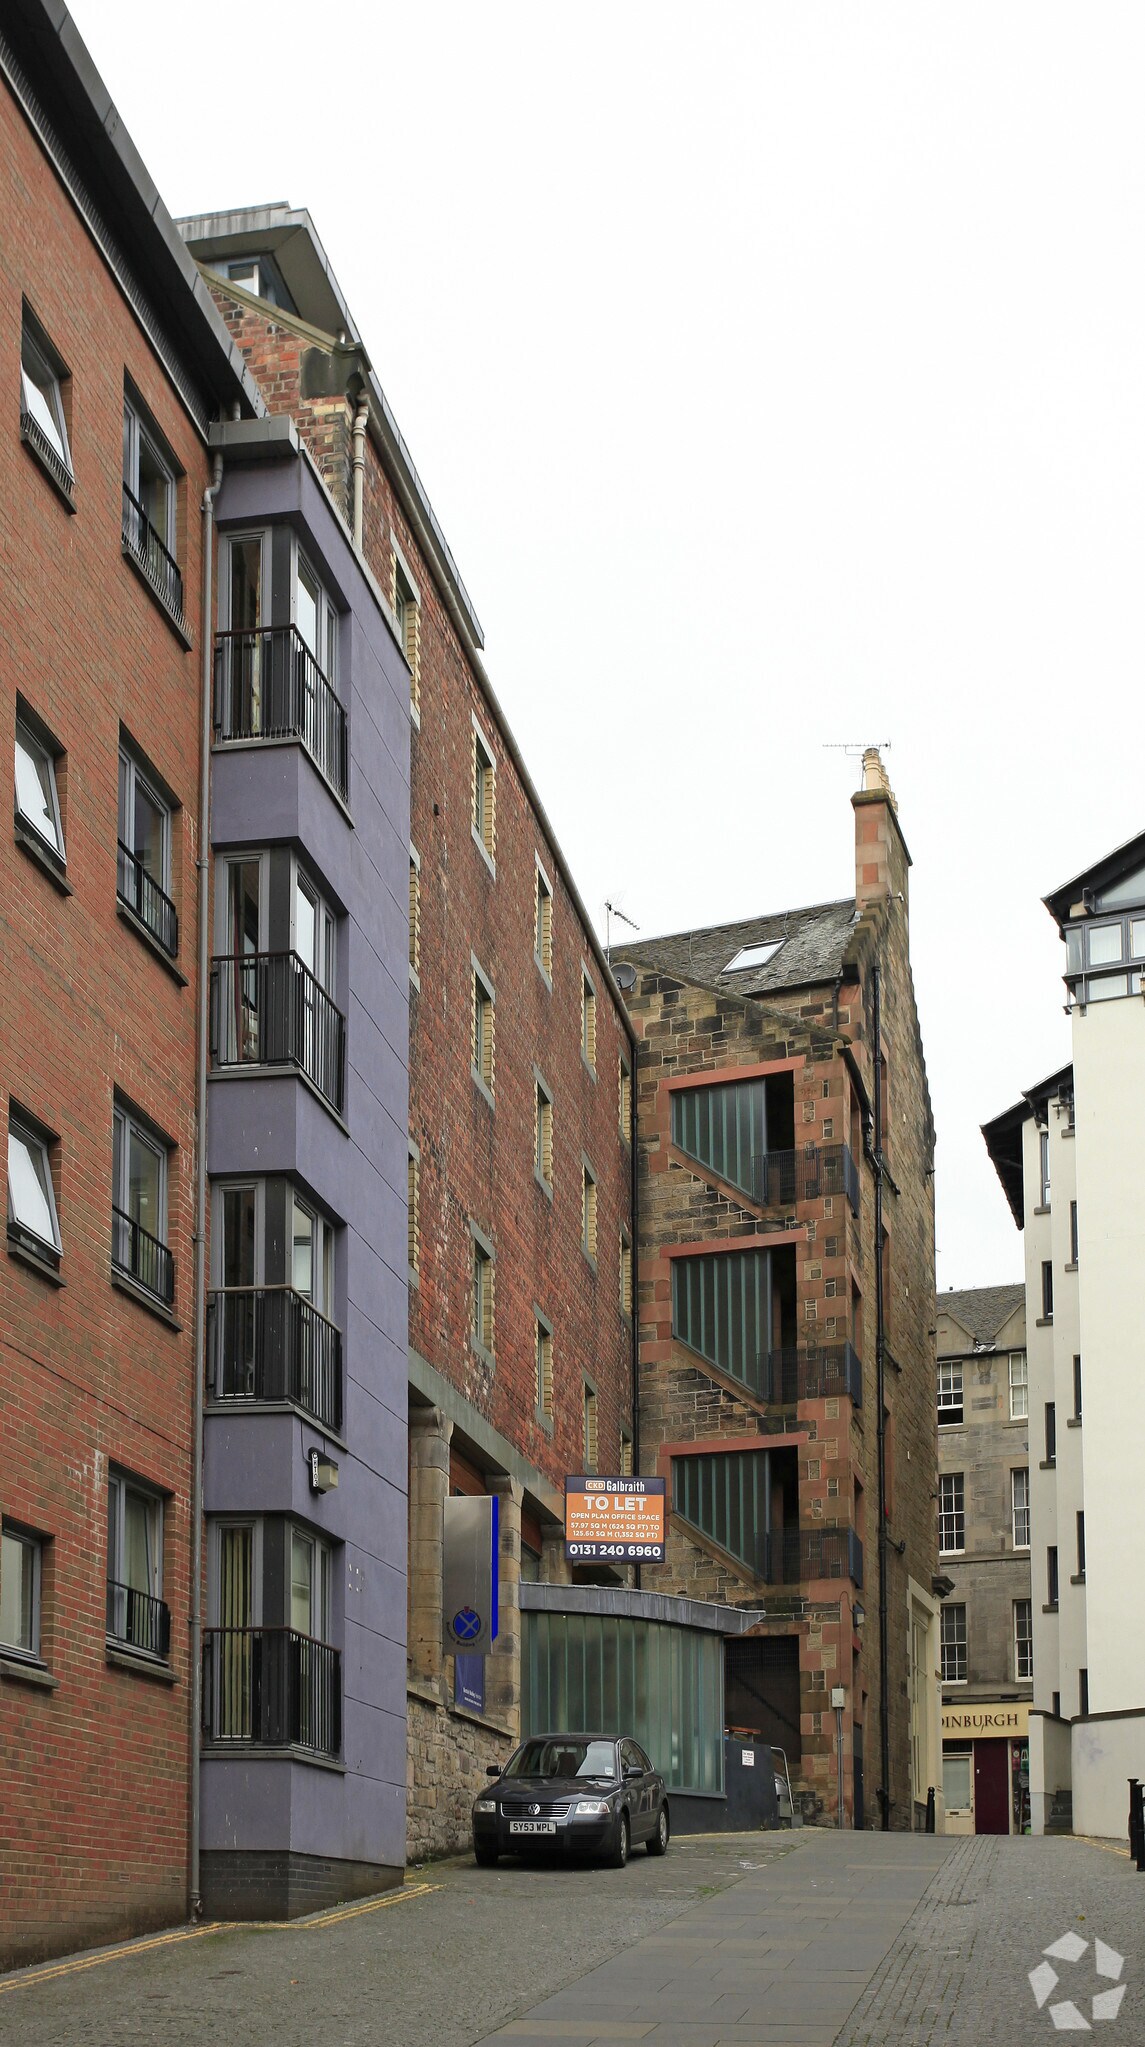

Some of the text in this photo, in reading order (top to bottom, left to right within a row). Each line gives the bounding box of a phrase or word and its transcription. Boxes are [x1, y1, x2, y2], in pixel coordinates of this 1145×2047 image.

[607, 1481, 644, 1492] Galbraith
[584, 1496, 646, 1511] TO LET
[570, 1544, 661, 1556] 0131 240 6960
[513, 1822, 552, 1832] SY53 WPL
